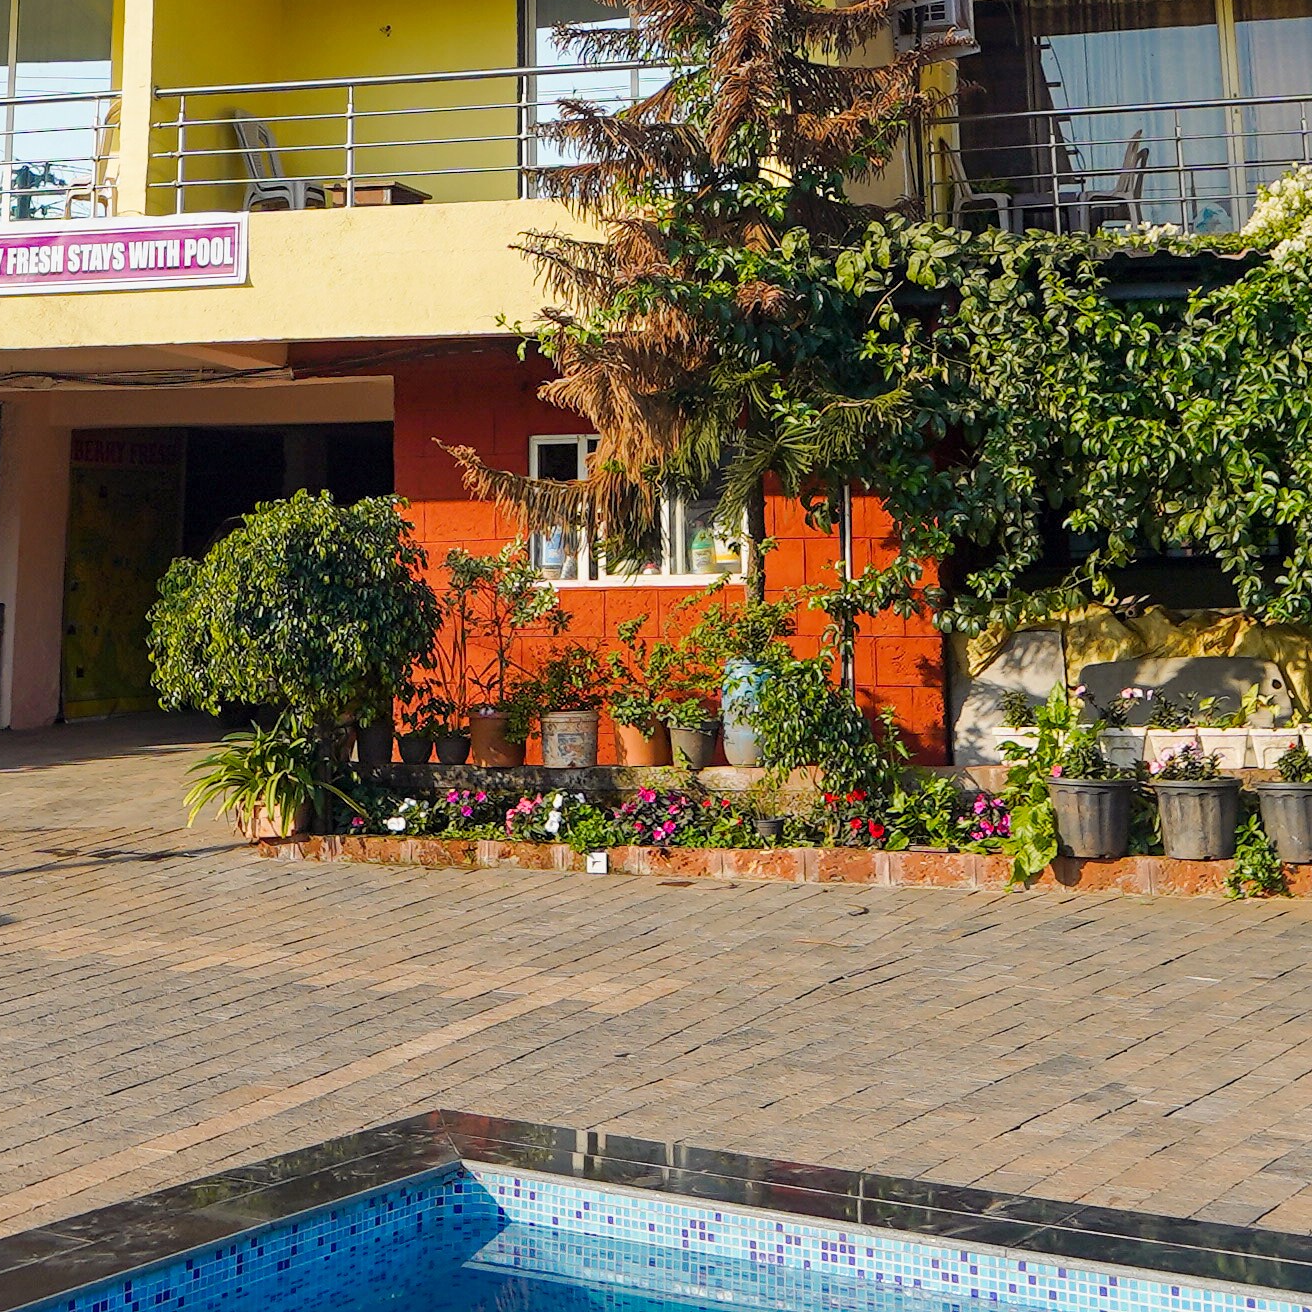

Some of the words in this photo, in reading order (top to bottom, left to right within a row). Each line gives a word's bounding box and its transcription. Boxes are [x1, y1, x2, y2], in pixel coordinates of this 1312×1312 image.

[6, 245, 65, 276] FRESH
[67, 242, 125, 273] STAYS
[128, 239, 181, 270] WITH
[183, 236, 234, 268] POOL
